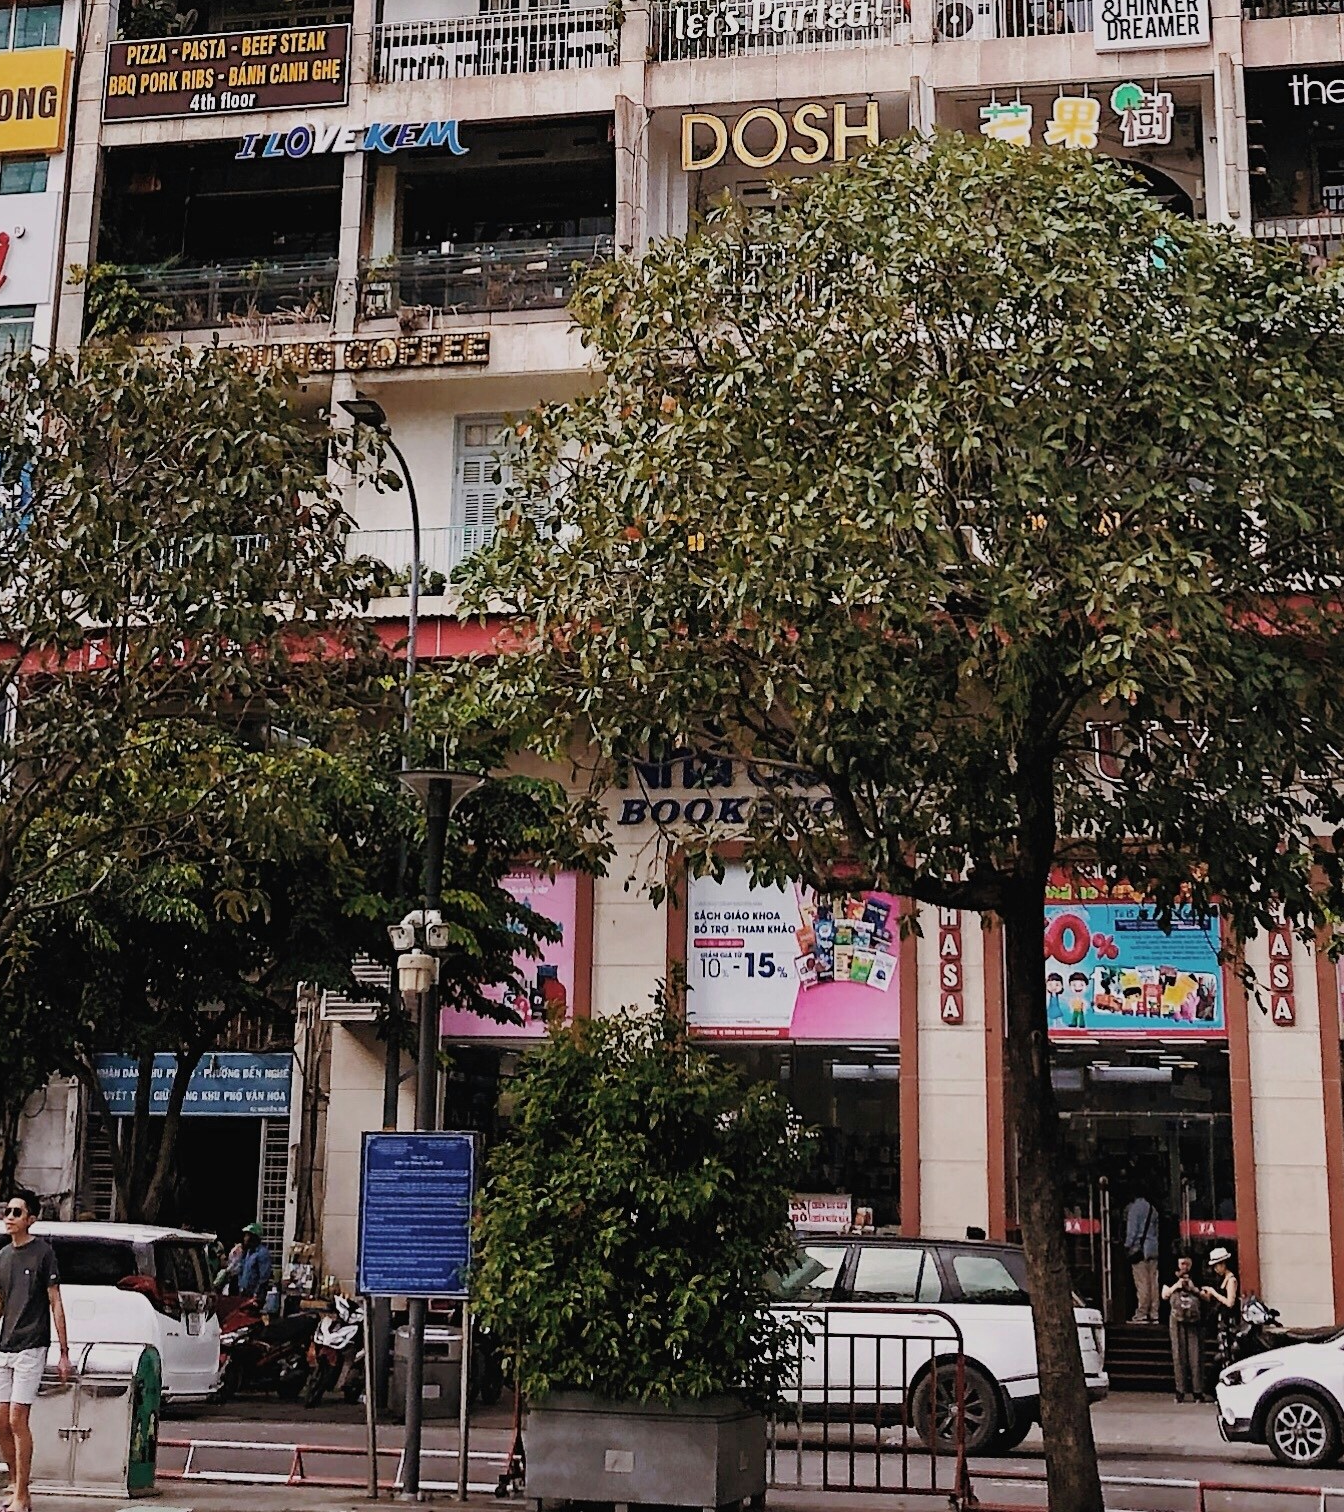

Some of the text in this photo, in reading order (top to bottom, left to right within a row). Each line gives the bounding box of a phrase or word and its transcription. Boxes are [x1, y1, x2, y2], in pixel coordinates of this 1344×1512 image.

[1106, 15, 1201, 41] DREAMER
[126, 31, 326, 65] PIZZA PASTA BEEF STEAK
[108, 74, 135, 96] BBQ
[140, 71, 178, 93] PORK
[182, 68, 214, 89] RIBS
[228, 60, 266, 87] BÁNH
[270, 61, 308, 83] CANH
[190, 92, 255, 112] 4th floor
[235, 119, 469, 159] I LOVE KEM
[682, 102, 879, 171] DOSH
[345, 333, 489, 368] COFFEE
[694, 909, 780, 920] SÁCH GIÁO KHOA
[737, 925, 765, 933] THAM
[1045, 914, 1119, 965] 0%
[104, 1089, 127, 1101] UYẾT
